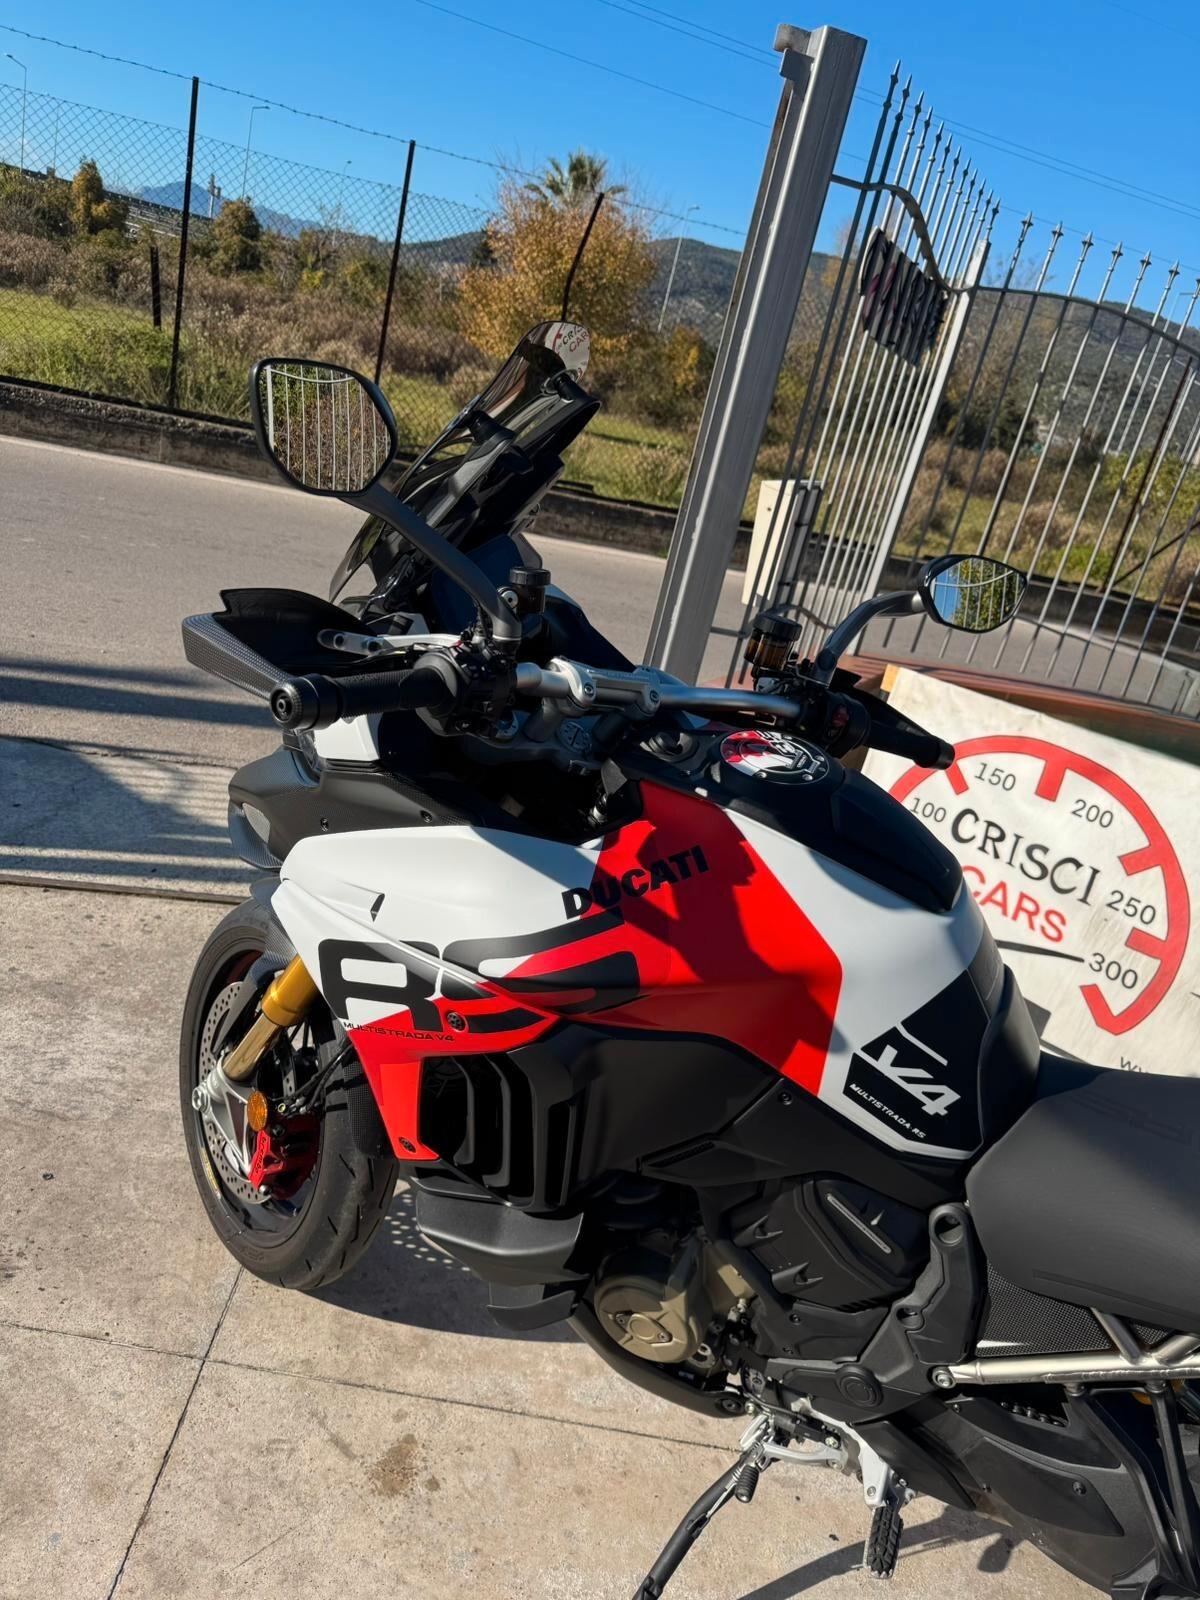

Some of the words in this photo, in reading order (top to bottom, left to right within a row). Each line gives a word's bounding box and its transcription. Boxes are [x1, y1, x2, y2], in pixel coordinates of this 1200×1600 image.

[974, 762, 1016, 791] 150
[910, 797, 947, 823] 100
[1071, 799, 1114, 828] 200
[951, 808, 1101, 906] CRISCI
[561, 845, 710, 920] DUCATI
[962, 865, 1067, 944] CARS
[1105, 890, 1157, 925] 250
[1089, 952, 1139, 990] 300
[343, 1021, 434, 1041] MULTISTRADA
[437, 1033, 456, 1042] V4
[876, 1044, 962, 1116] V4
[849, 1083, 912, 1129] MULTISTRADA
[911, 1127, 927, 1140] RS
